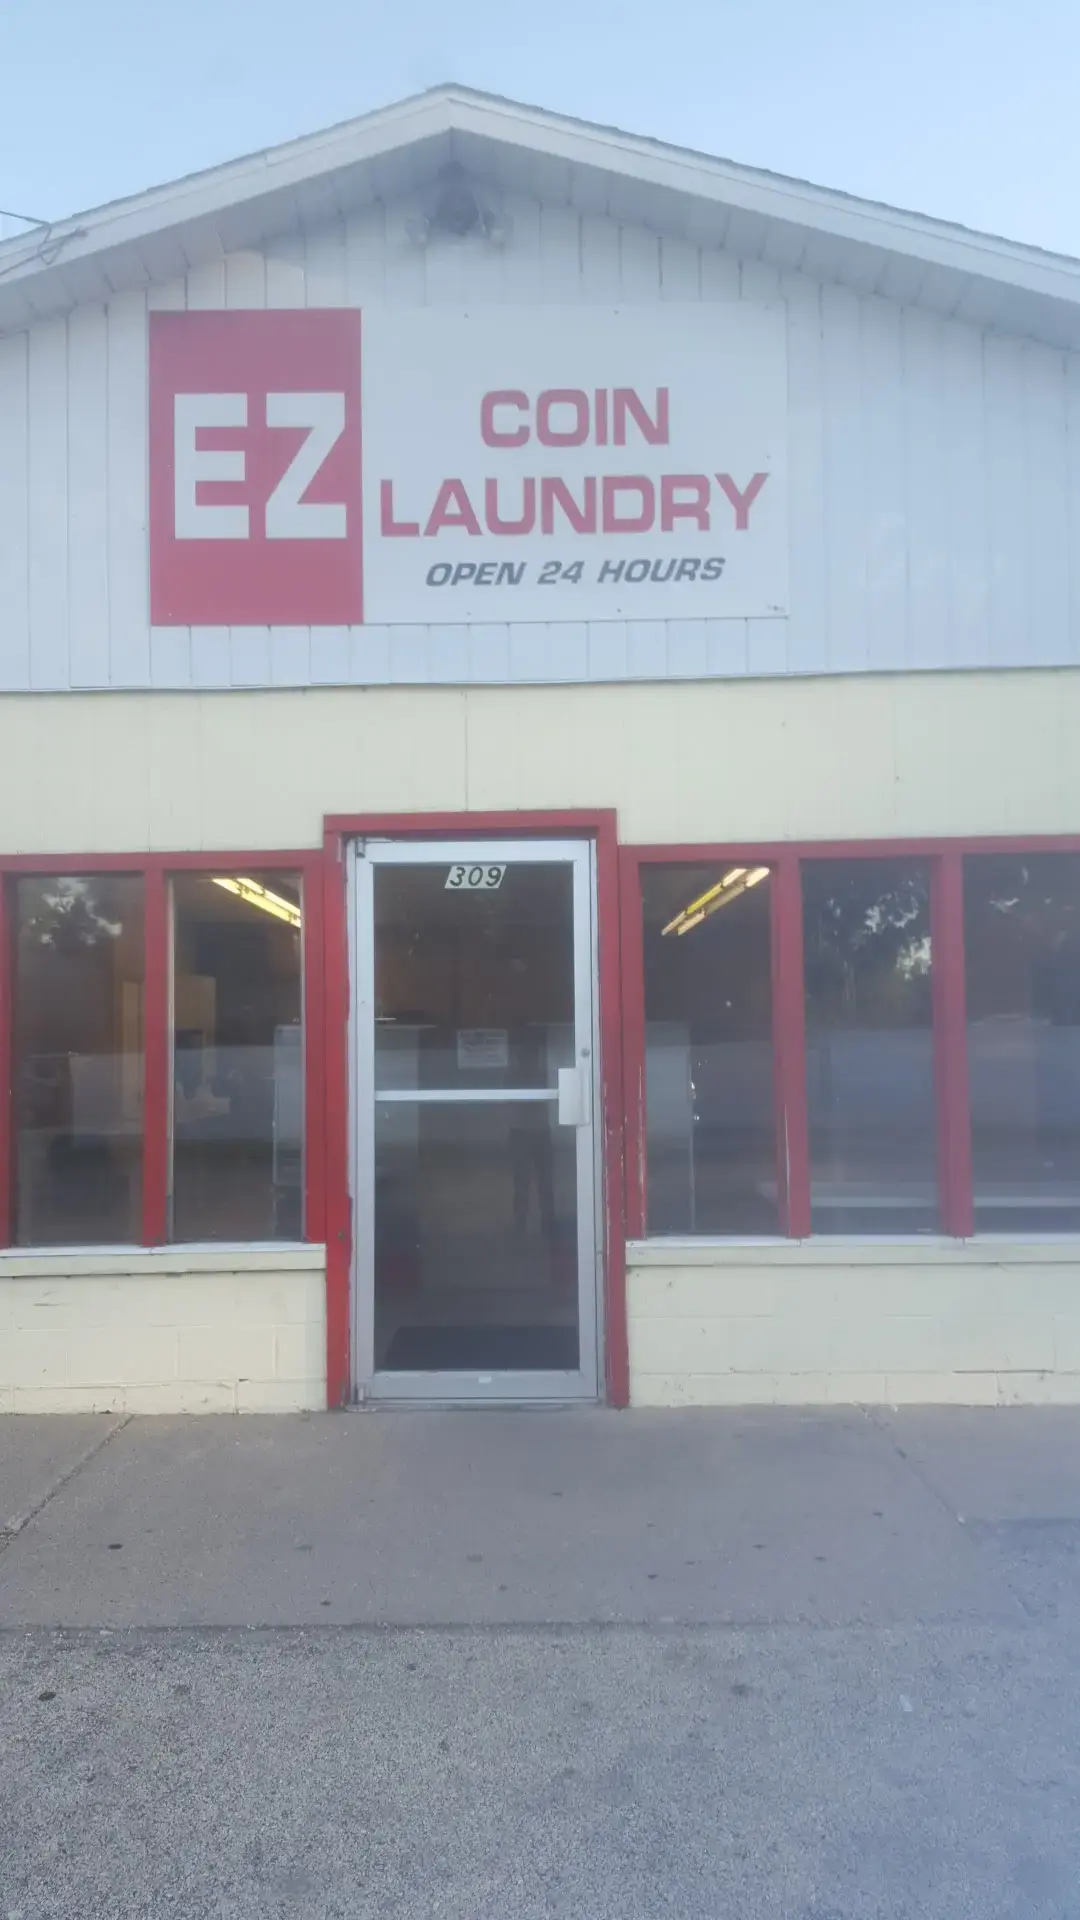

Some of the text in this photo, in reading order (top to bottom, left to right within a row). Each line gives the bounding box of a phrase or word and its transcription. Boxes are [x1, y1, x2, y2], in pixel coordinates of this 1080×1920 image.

[480, 387, 669, 447] COIN
[174, 392, 347, 539] EZ
[380, 473, 769, 536] LAUNDRY
[425, 557, 726, 587] OPEN 24 HOURS
[449, 866, 502, 887] 309
